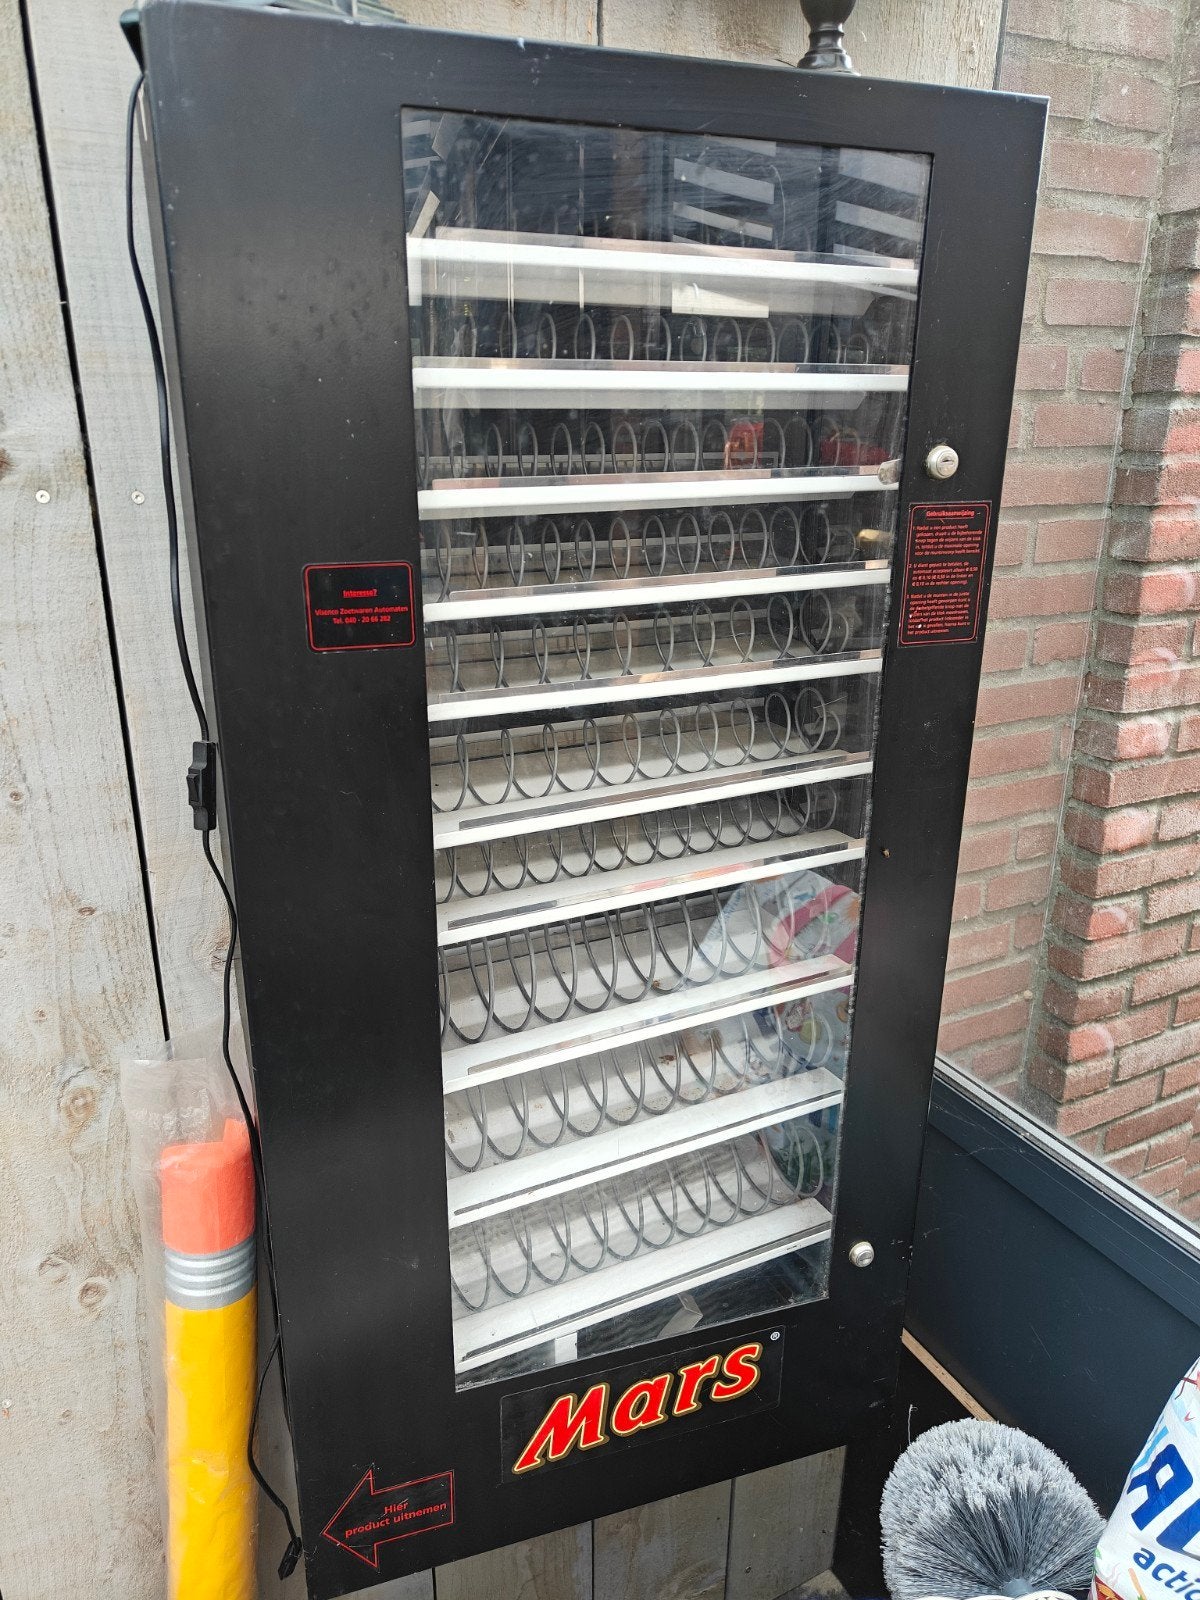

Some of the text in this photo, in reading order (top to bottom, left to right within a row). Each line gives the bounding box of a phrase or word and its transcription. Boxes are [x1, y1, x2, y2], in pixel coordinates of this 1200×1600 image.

[343, 588, 378, 598] Interesse?
[512, 1342, 764, 1475] Mars
[384, 1501, 409, 1514] Hier
[344, 1502, 448, 1538] product uitnemen
